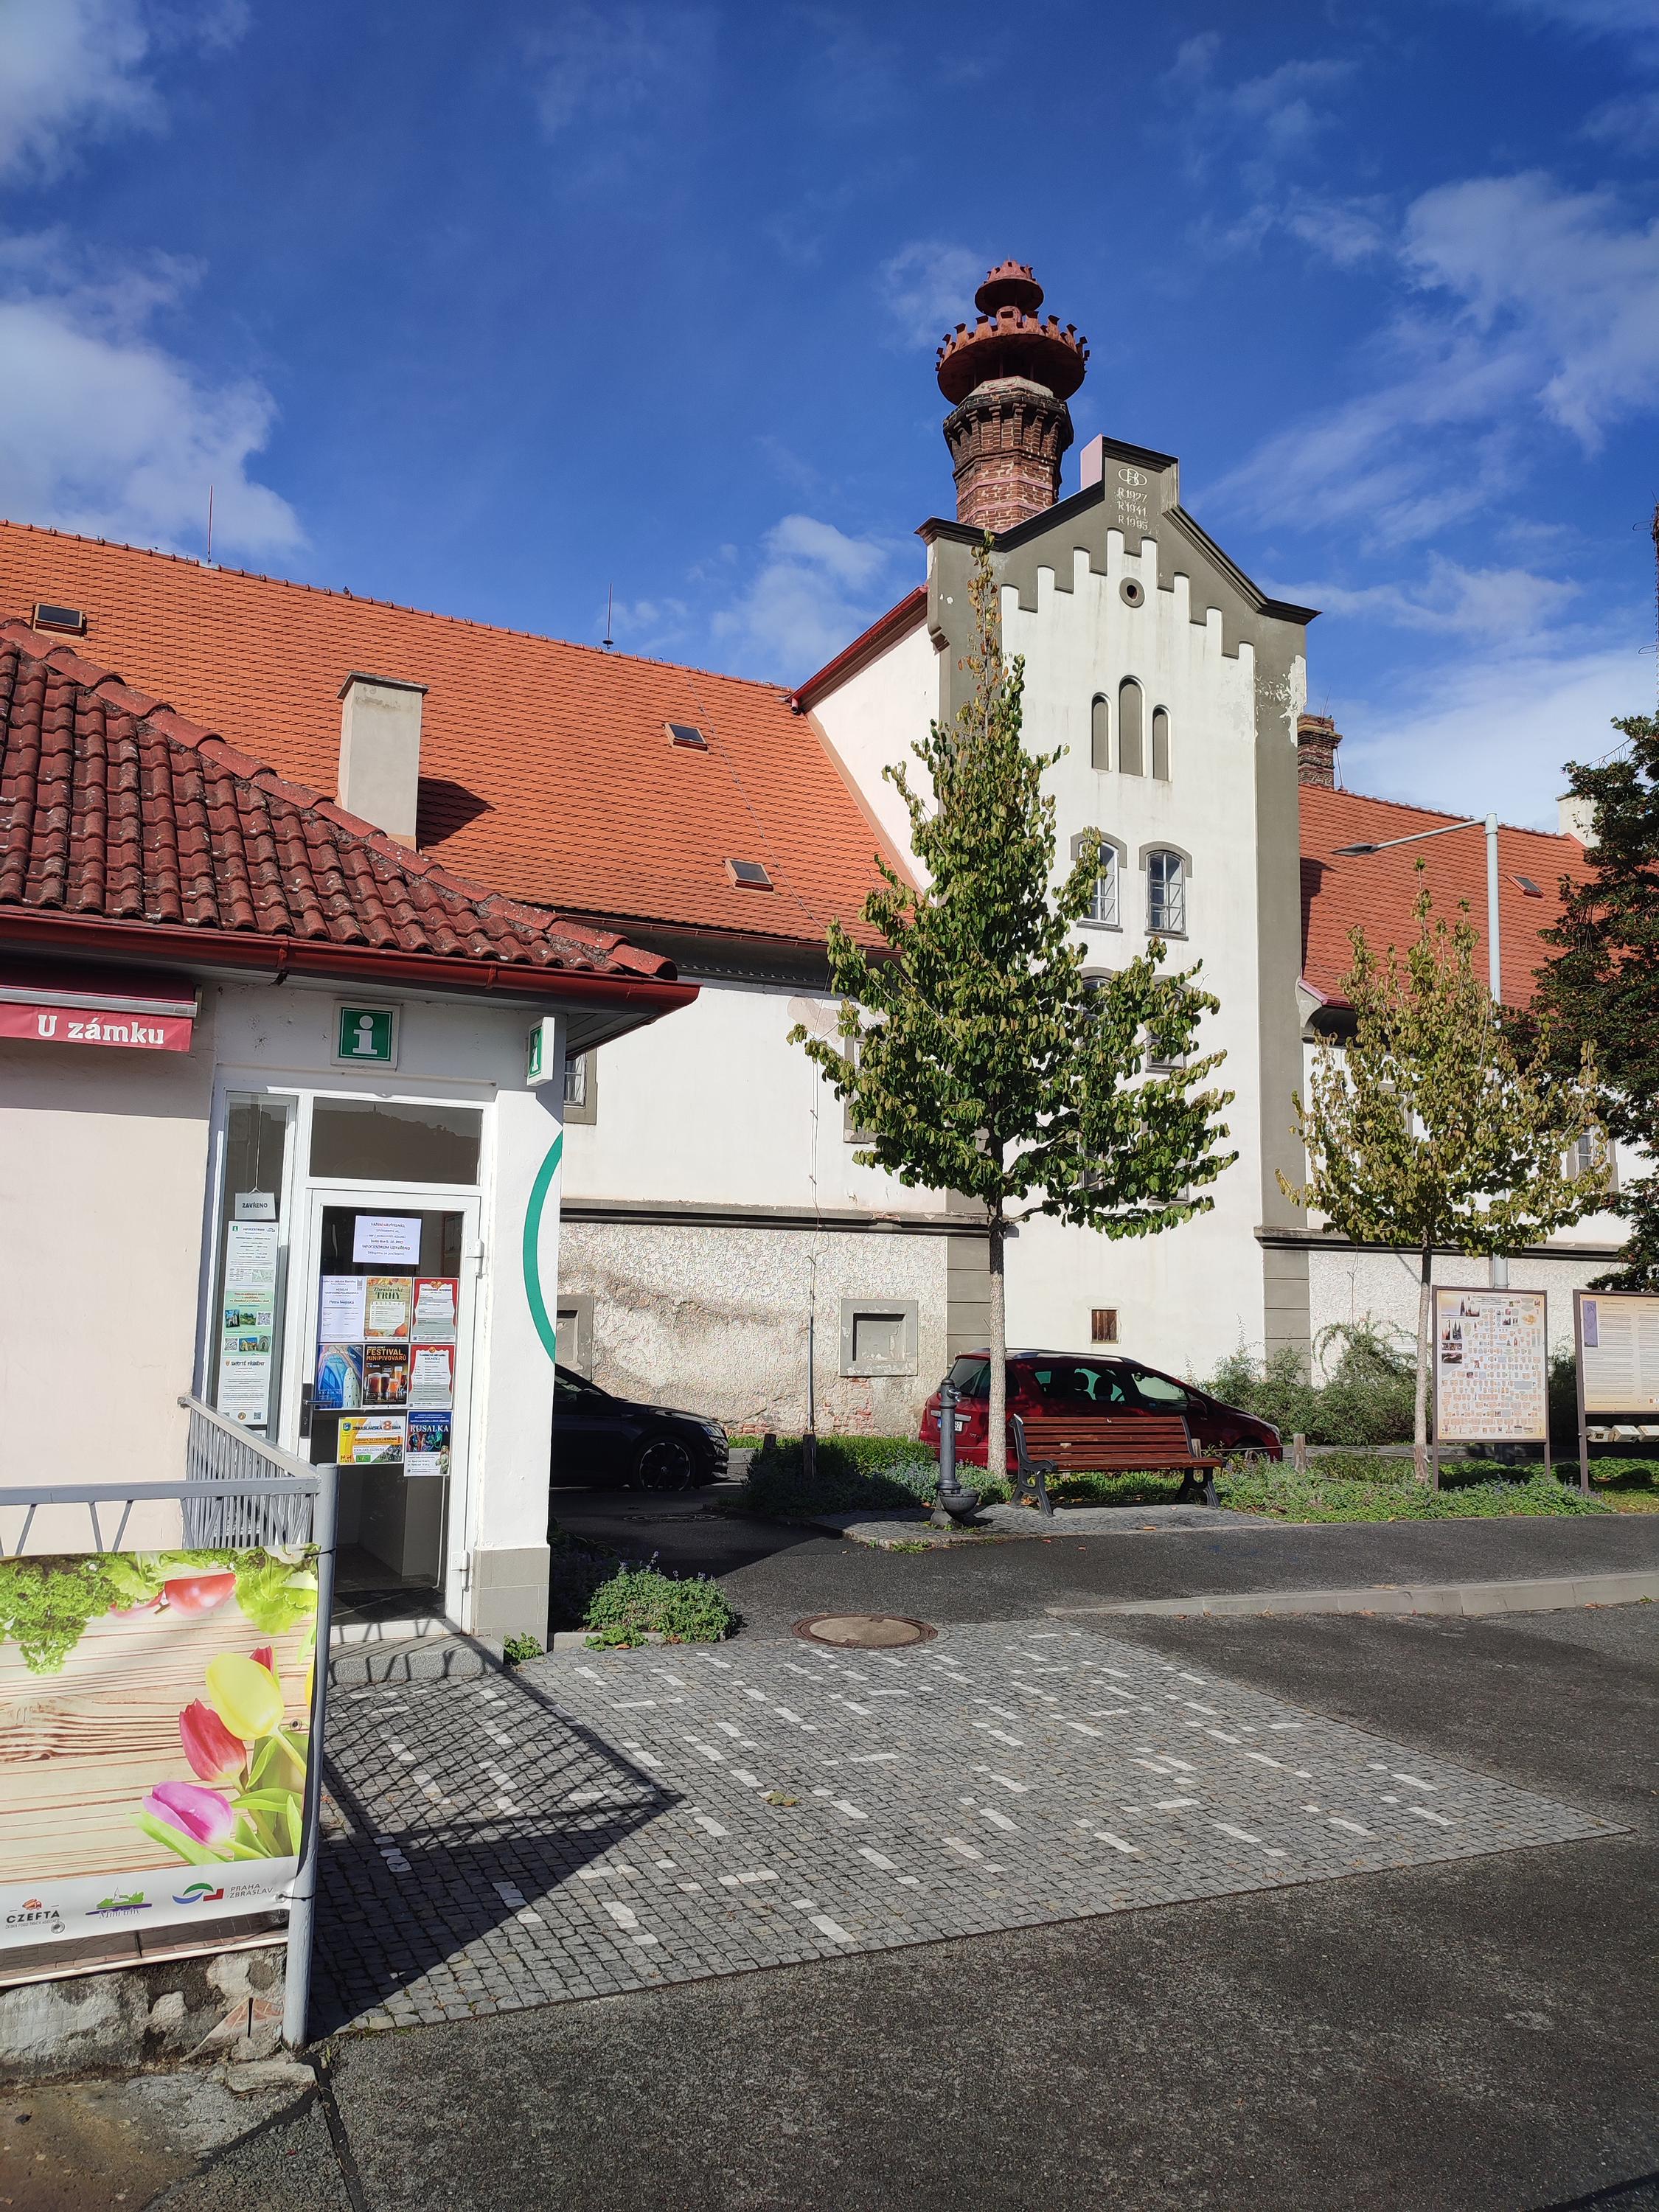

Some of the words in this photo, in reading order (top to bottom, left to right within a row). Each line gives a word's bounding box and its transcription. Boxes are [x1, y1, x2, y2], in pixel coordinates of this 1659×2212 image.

[38, 1015, 58, 1037] U
[68, 1018, 164, 1046] zámku
[410, 1425, 449, 1433] RUSALKA
[231, 1883, 260, 1892] PRAHA
[229, 1888, 274, 1899] ZBRASLAV
[6, 1910, 60, 1924] CZEFTA
